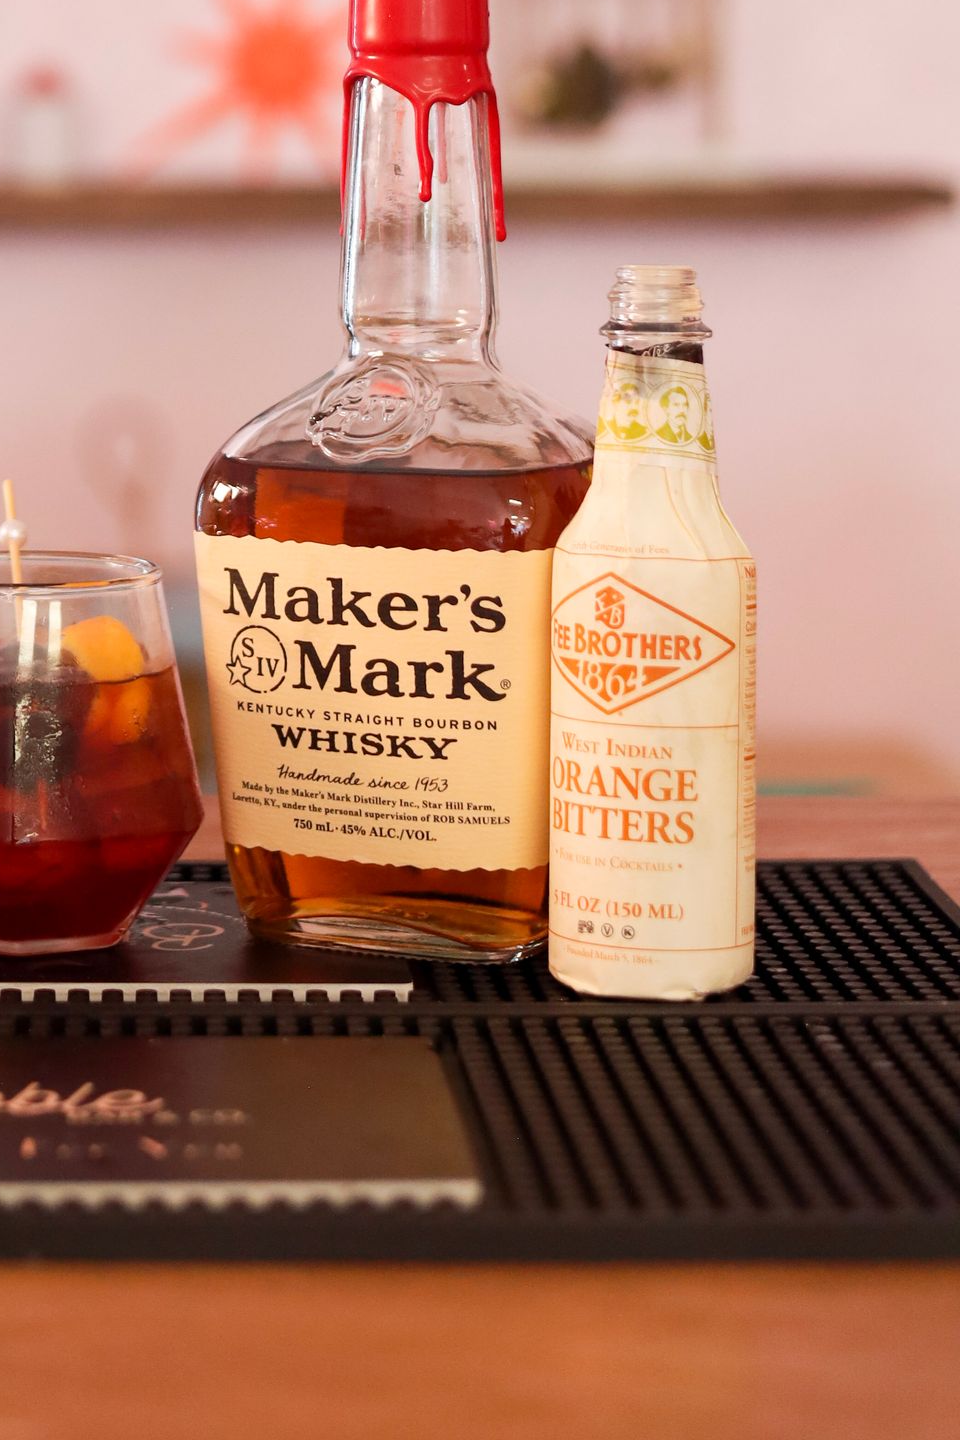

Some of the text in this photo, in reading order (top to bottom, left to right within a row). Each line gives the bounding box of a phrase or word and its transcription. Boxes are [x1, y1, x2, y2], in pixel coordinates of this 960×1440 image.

[222, 567, 506, 633] Maker's
[241, 637, 255, 658] S
[574, 623, 703, 662] BROTHERS
[256, 657, 280, 678] IV
[236, 701, 498, 731] KENTUCKY STRAIGHT BOURBON
[271, 723, 458, 760] WHISKY
[562, 731, 673, 760] WEST INDIAN
[277, 764, 450, 793] Handmade since 1953
[552, 755, 699, 803] ORANGE
[232, 792, 263, 806] Loretto,
[282, 800, 306, 812] under
[308, 803, 322, 813] the
[324, 806, 363, 818] personal
[364, 809, 418, 823] supervision
[420, 813, 432, 823] of
[433, 814, 456, 824] ROB
[457, 815, 511, 825] SAMUELS
[241, 780, 264, 792] Made
[264, 784, 275, 795] by
[276, 785, 290, 796] the
[291, 787, 325, 800] Maker's
[327, 792, 352, 803] Mark
[353, 793, 398, 808] Distillery
[399, 798, 420, 810] Inc.,
[422, 799, 443, 810] Star
[445, 800, 465, 811] Hill
[293, 818, 313, 831] 750
[369, 826, 438, 842] ALC./VOL.
[552, 796, 695, 845] BITTERS
[560, 891, 574, 909] FL
[577, 894, 600, 914] OZ
[605, 898, 641, 920] (150
[647, 904, 684, 920] ML)
